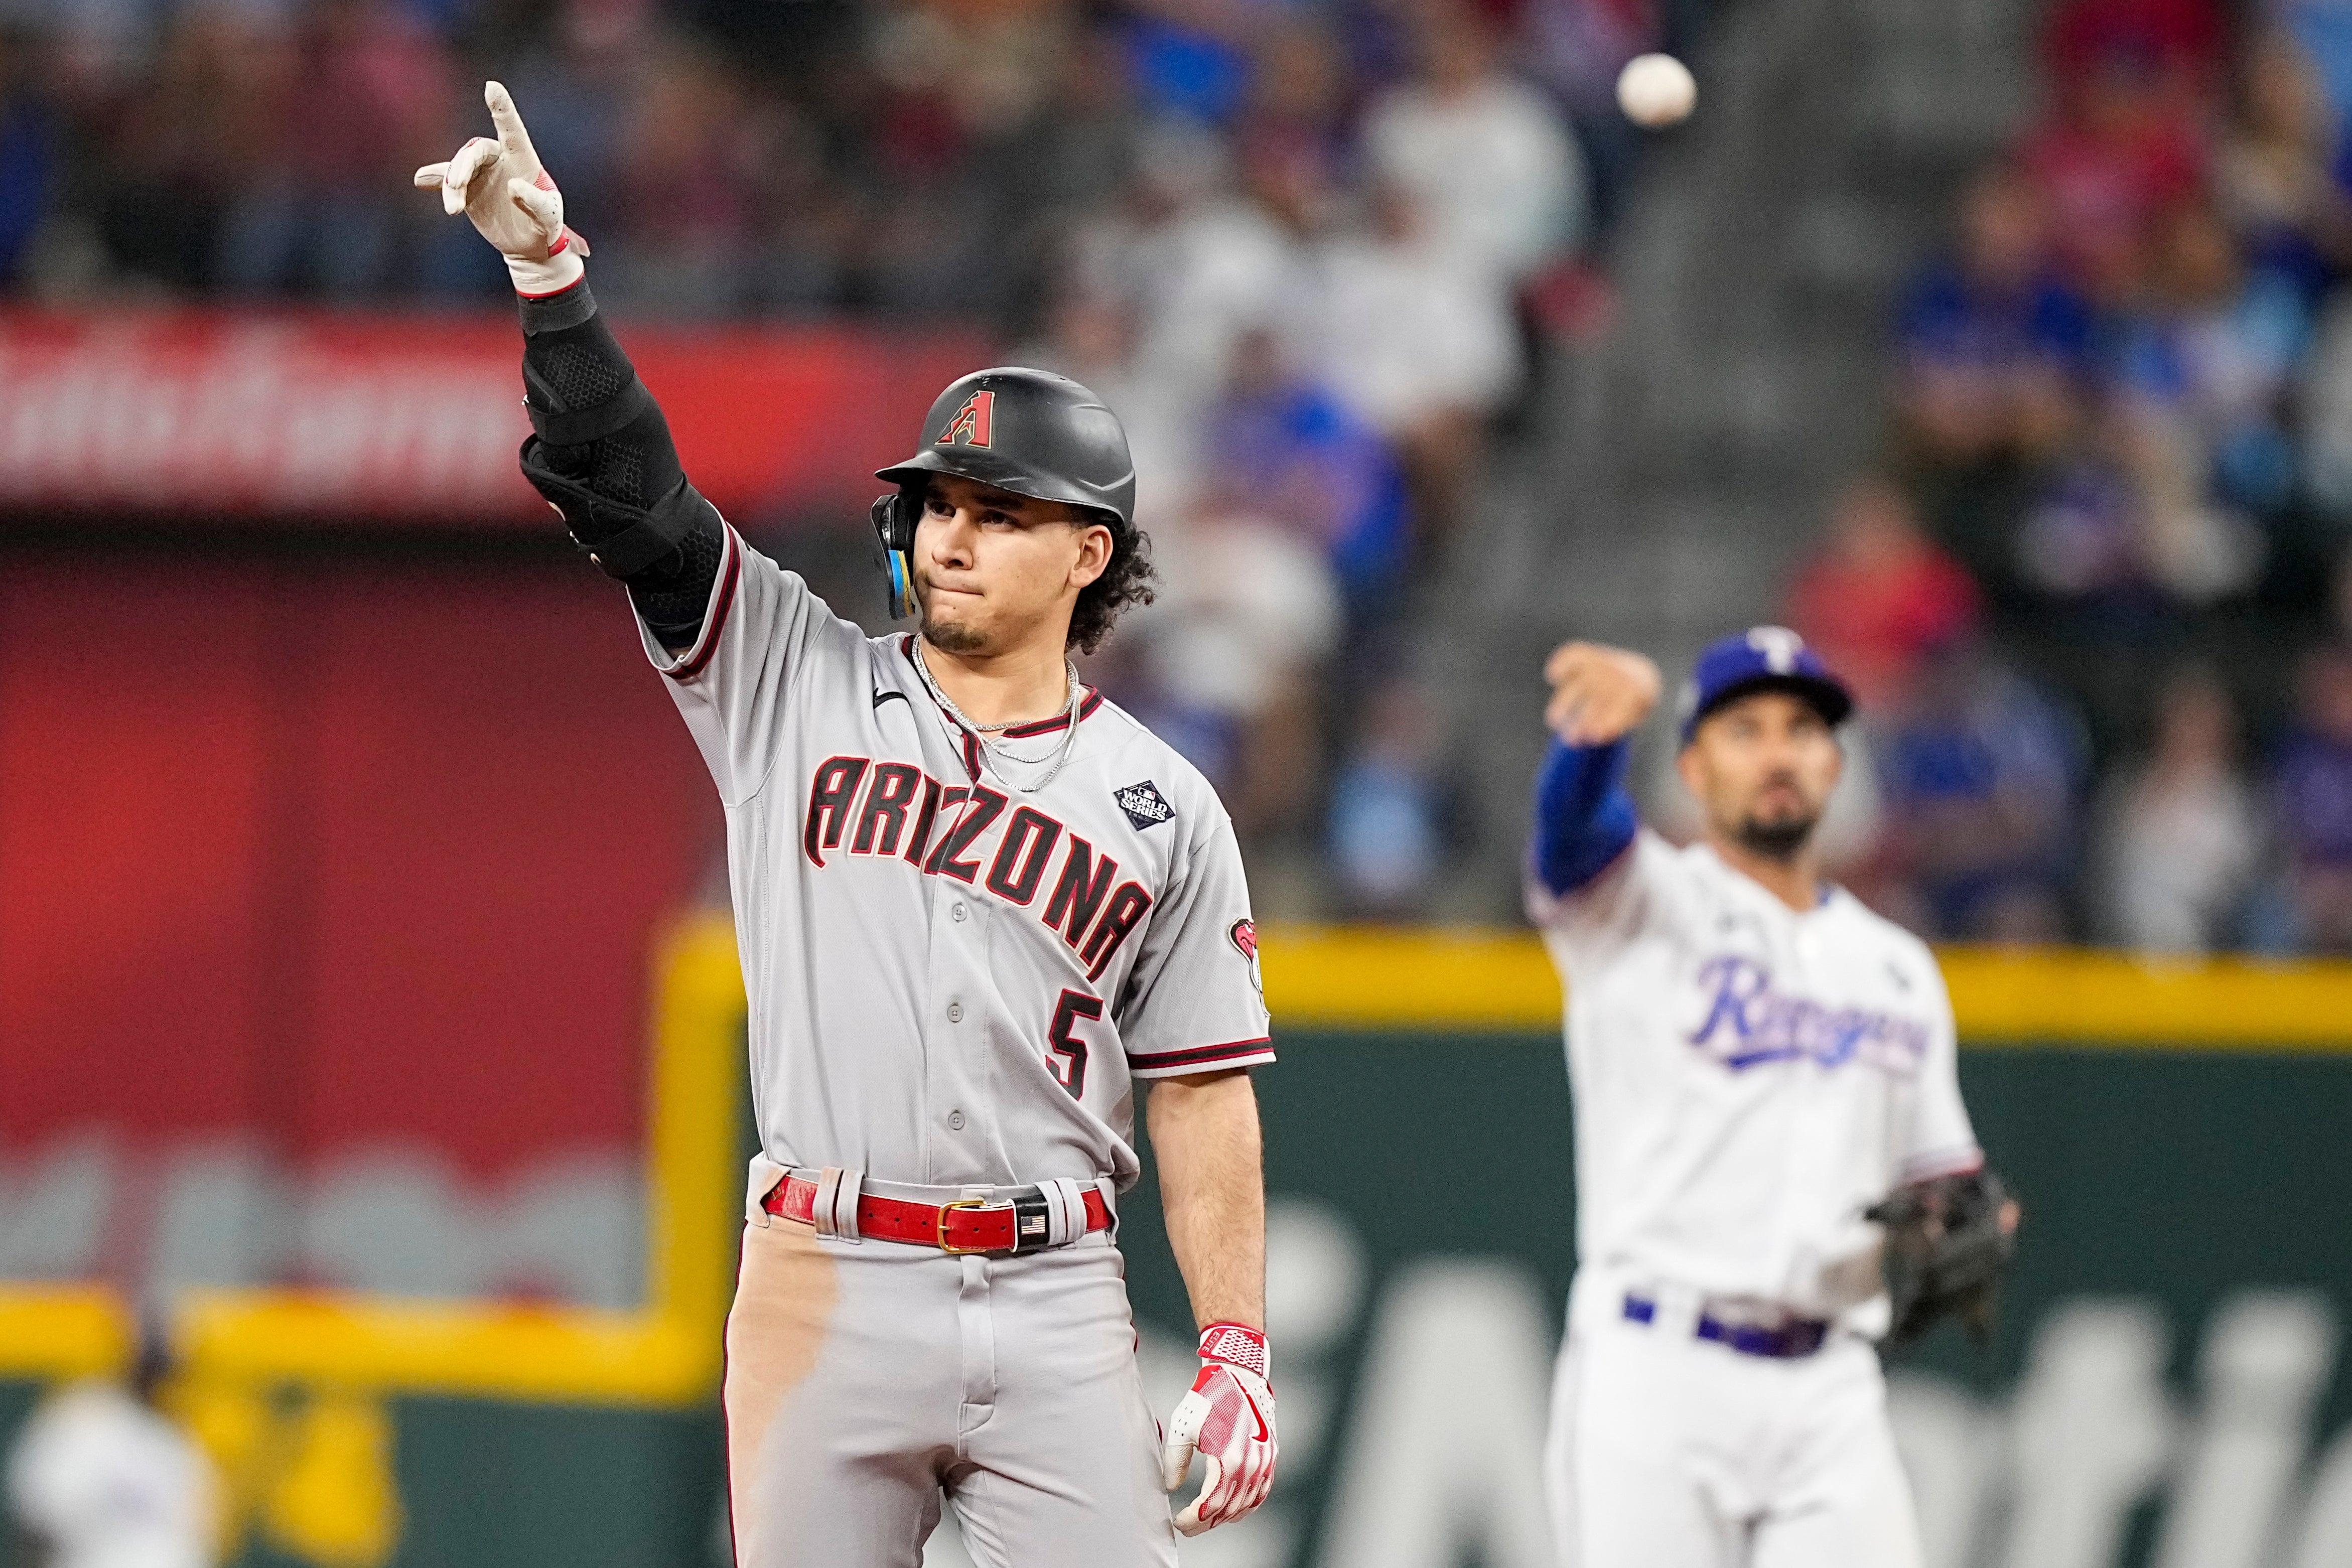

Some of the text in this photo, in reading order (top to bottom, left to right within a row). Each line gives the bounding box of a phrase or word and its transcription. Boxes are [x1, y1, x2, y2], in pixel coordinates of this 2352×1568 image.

[935, 390, 996, 449] A
[1120, 798, 1166, 821] SERIES
[1123, 788, 1168, 813] WORLD
[803, 754, 1155, 983] ARIZONA
[1045, 987, 1104, 1102] 5
[1202, 1331, 1220, 1353] ELITE
